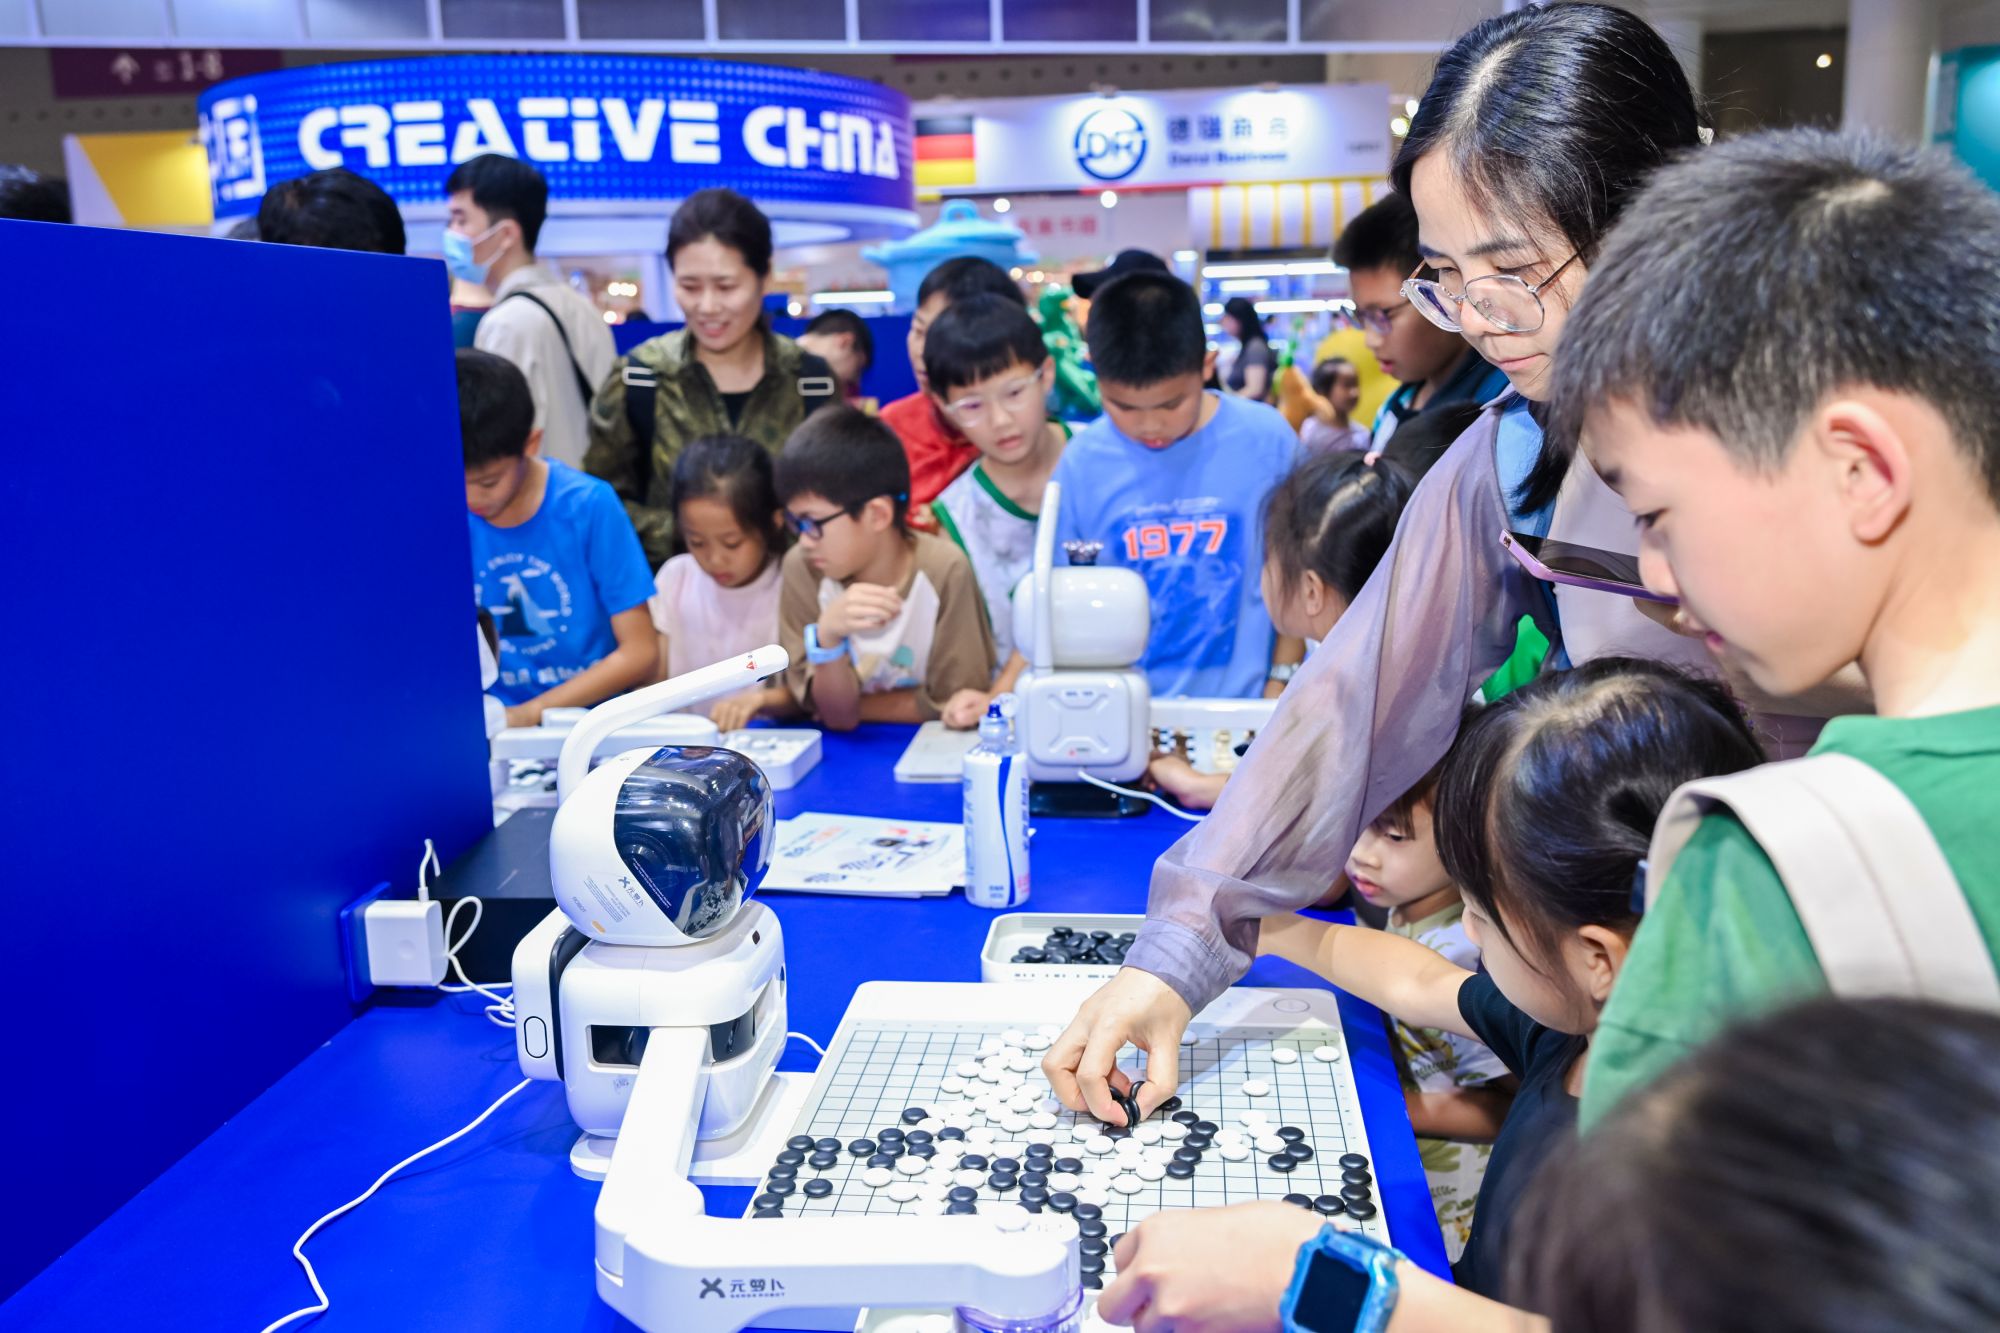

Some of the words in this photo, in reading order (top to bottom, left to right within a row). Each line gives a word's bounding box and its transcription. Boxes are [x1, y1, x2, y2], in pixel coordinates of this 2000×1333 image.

[1122, 519, 1228, 561] 1977
[730, 1278, 785, 1292] 元萝卜
